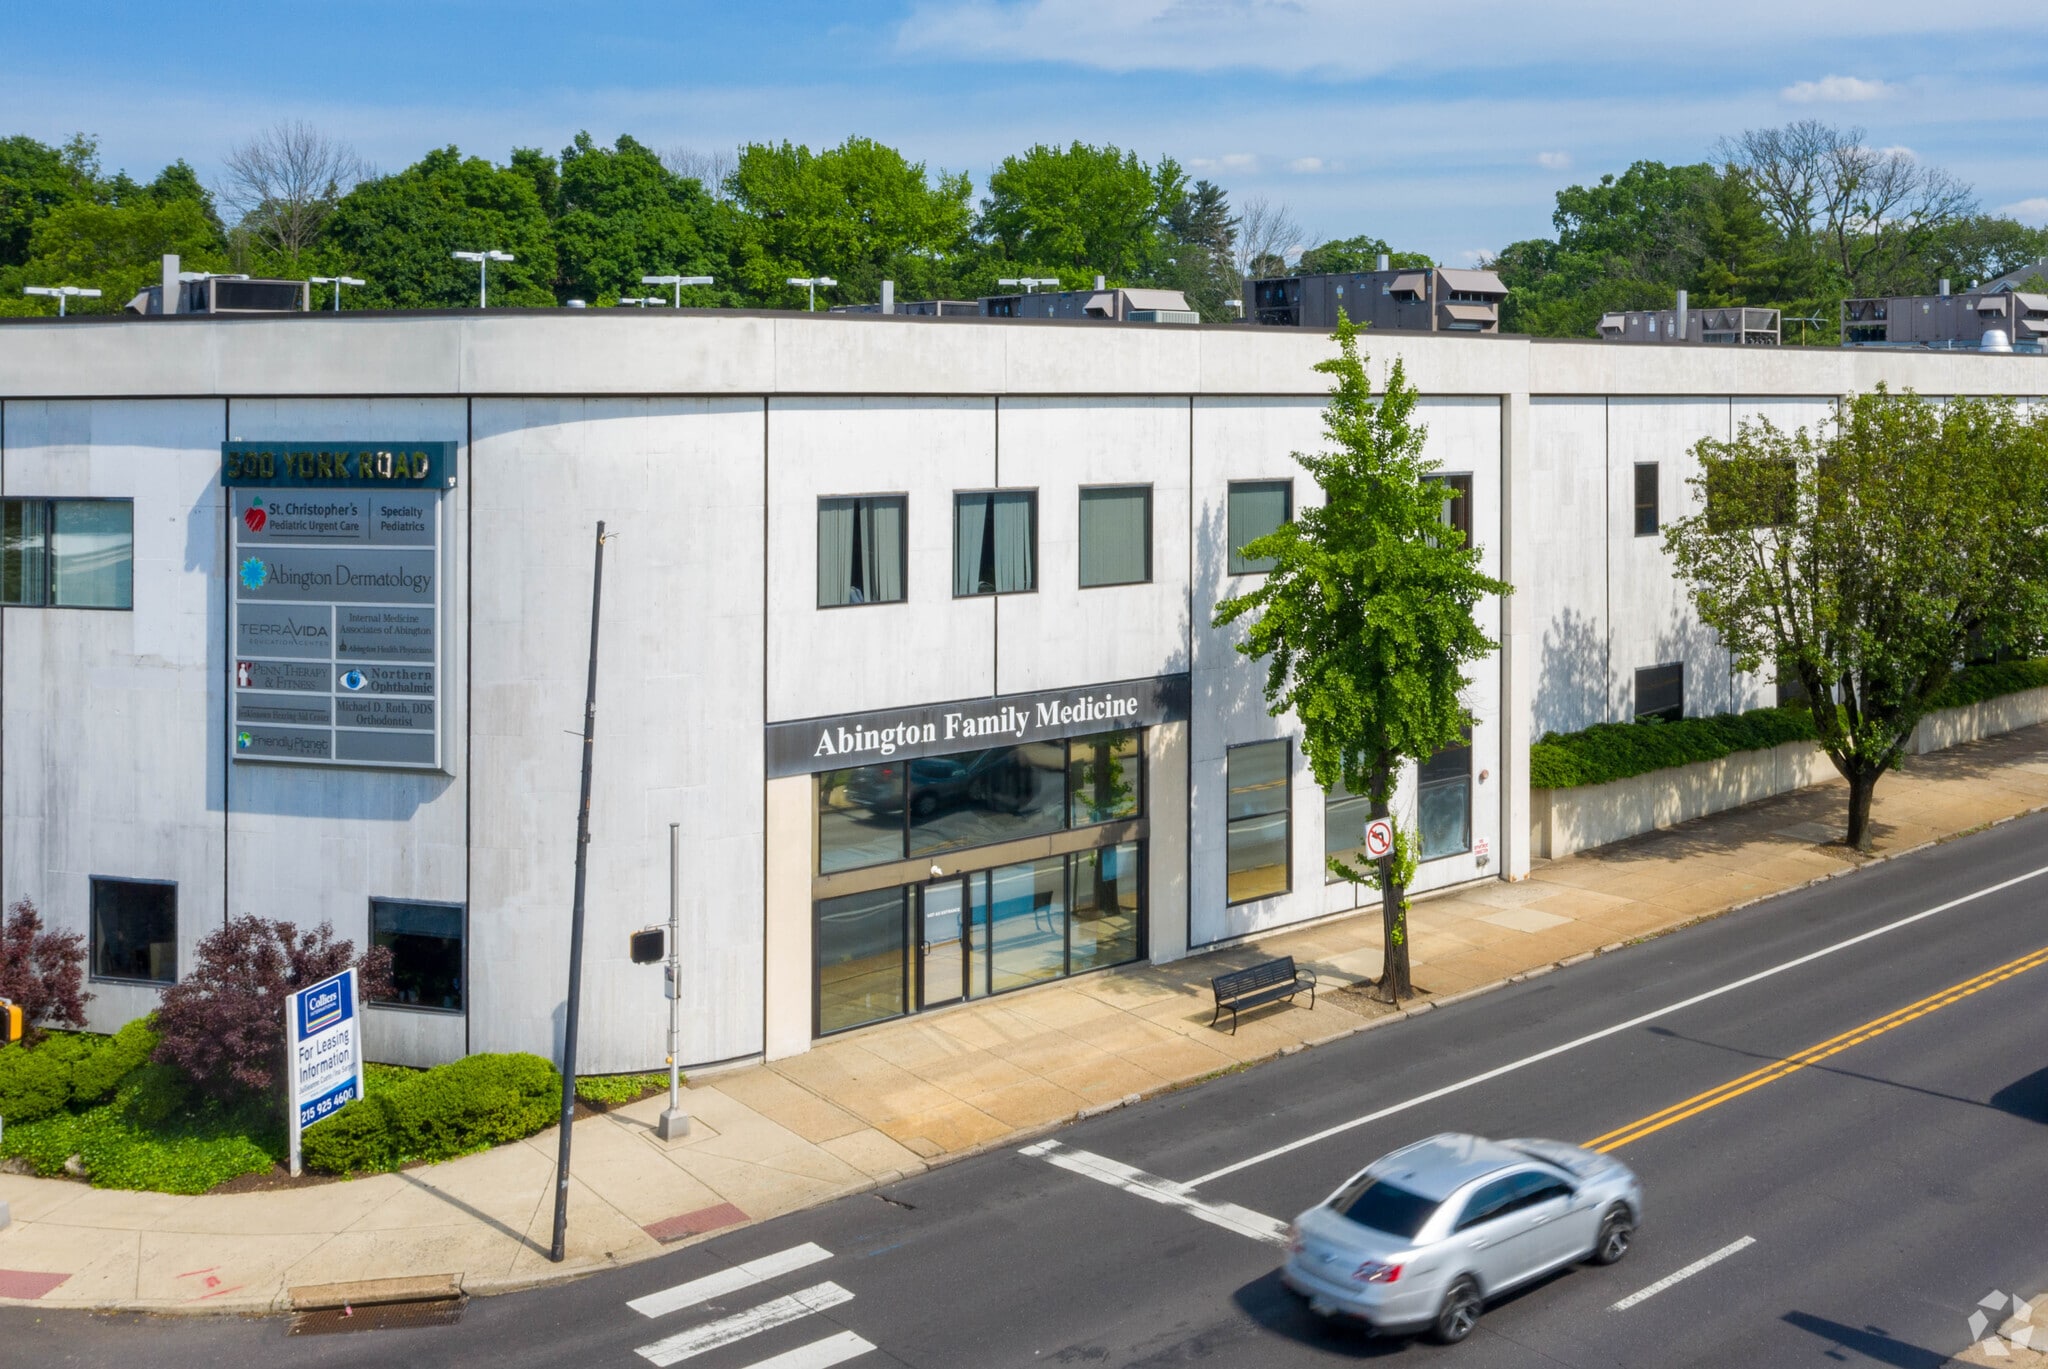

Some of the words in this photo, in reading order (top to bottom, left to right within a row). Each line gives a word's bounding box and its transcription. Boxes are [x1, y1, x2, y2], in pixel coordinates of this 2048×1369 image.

[228, 451, 274, 478] 500
[283, 451, 351, 479] YORK
[358, 451, 430, 480] ROAD
[269, 502, 284, 516] St.
[285, 502, 358, 518] Christopher's
[381, 506, 423, 519] Specialty
[269, 520, 307, 531] Pediatric
[308, 521, 338, 533] Urgent
[340, 521, 360, 531] Care
[381, 521, 425, 532] Pediatrics
[267, 562, 332, 591] Abington
[336, 564, 432, 593] Dermatology
[349, 613, 381, 623] Internal
[383, 614, 420, 623] Medicine
[340, 625, 382, 634] Associates
[383, 625, 392, 635] of
[394, 626, 432, 637] Abington
[371, 668, 432, 680] Northern
[264, 677, 273, 688] &
[371, 681, 433, 694] Ophthalmic
[336, 700, 371, 712] Michael
[373, 702, 383, 713] D.
[386, 702, 410, 714] Roth,
[412, 703, 433, 714] DDS
[356, 714, 413, 727] Orthodontist
[813, 719, 937, 758] Abington
[943, 706, 1030, 741] Family
[1035, 693, 1139, 728] Medicine
[309, 992, 337, 1011] Colliers
[299, 1046, 313, 1064] For
[316, 1029, 350, 1055] Leasing
[299, 1048, 350, 1084] Information
[301, 1106, 316, 1124] 215
[316, 1097, 333, 1115] 925
[333, 1087, 354, 1106] 4600
